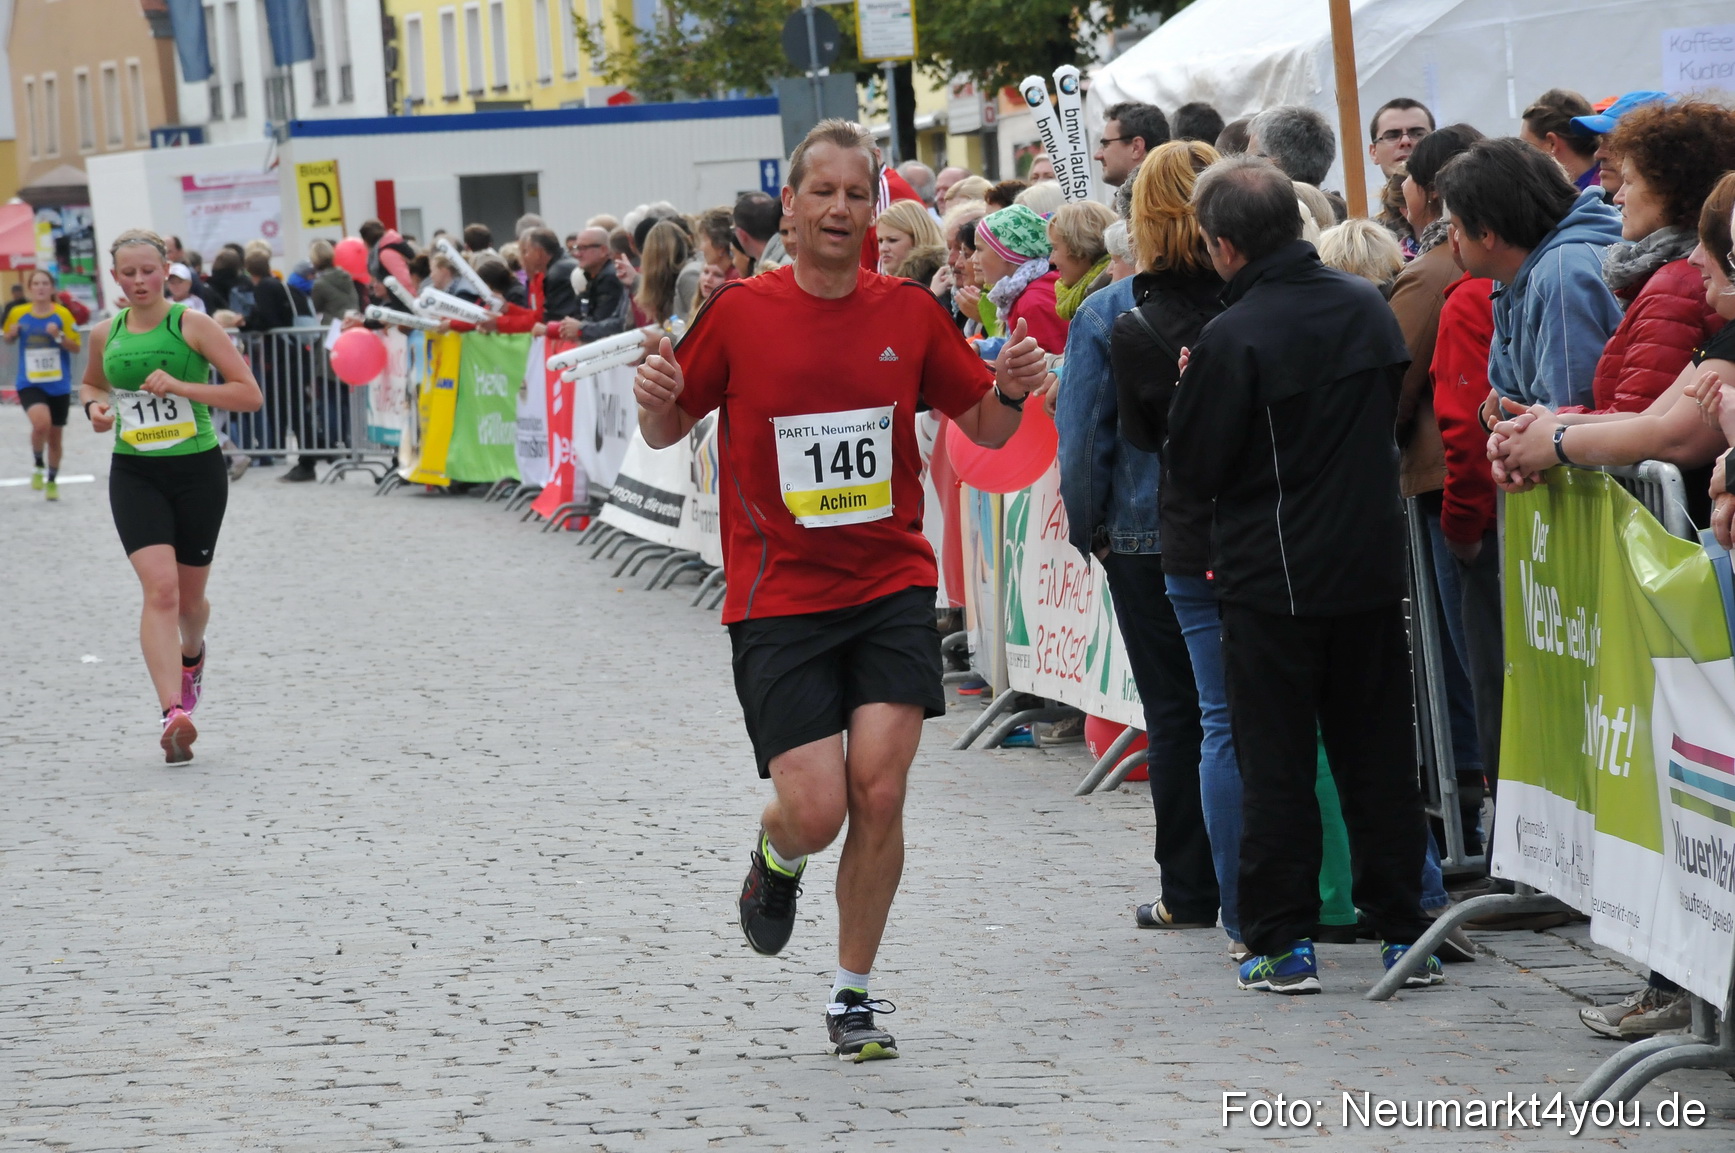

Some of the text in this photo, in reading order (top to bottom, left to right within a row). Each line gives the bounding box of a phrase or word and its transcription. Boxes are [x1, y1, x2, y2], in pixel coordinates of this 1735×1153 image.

[300, 164, 335, 177] Block
[309, 181, 332, 213] D
[132, 397, 178, 424] 113
[136, 428, 180, 442] Christina
[778, 421, 876, 439] PARTL Neumarkt
[804, 437, 877, 483] 146
[820, 492, 867, 511] Achim
[1532, 511, 1550, 562] Der
[1519, 560, 1564, 656] Neue
